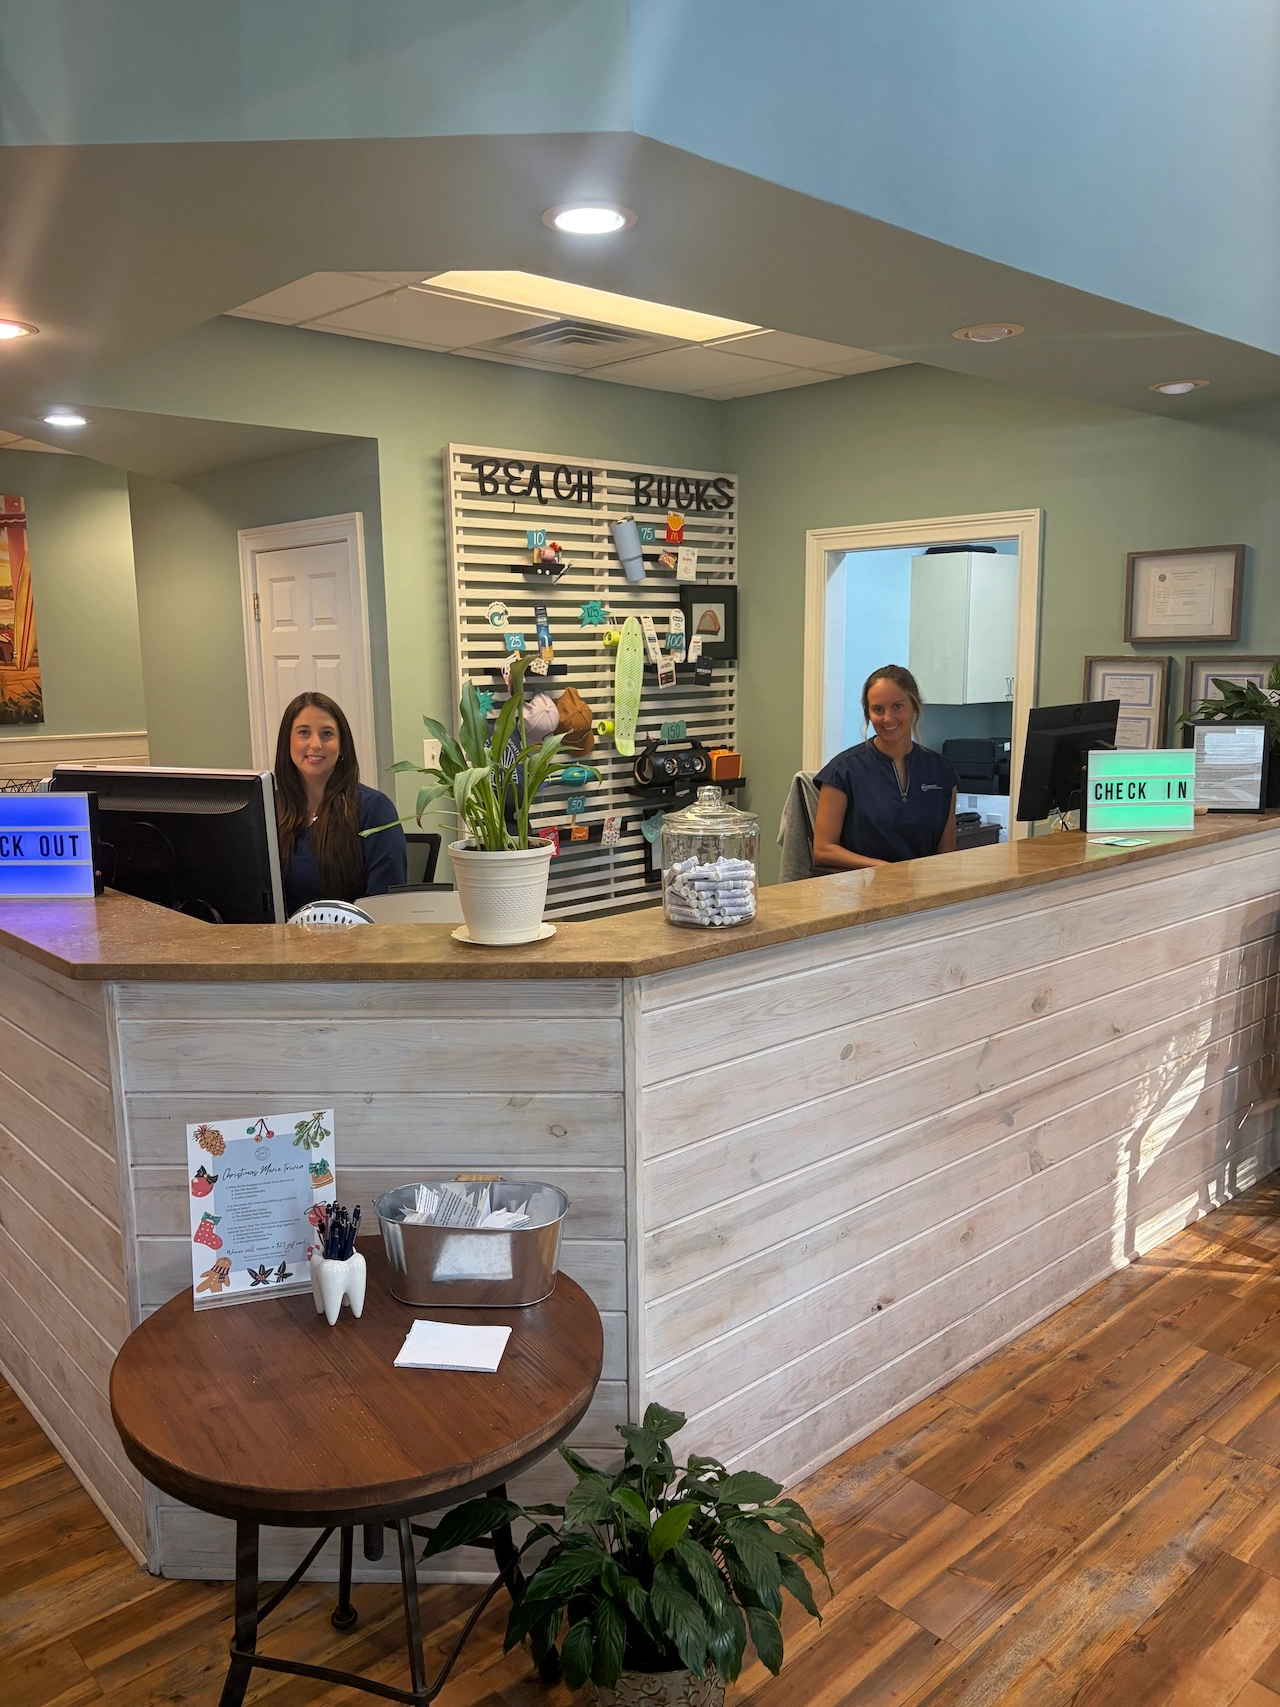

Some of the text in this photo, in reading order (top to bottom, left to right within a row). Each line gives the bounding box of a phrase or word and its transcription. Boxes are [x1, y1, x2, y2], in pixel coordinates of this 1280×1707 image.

[471, 458, 734, 511] BEACH BUCKS
[533, 532, 544, 546] 10
[641, 527, 653, 541] 75
[586, 605, 600, 618] 125
[509, 635, 522, 648] 25
[666, 634, 683, 647] 100
[667, 724, 681, 739] 150
[1094, 781, 1187, 800] CHECK IN
[571, 799, 583, 811] 50
[39, 835, 79, 857] OUT
[222, 1166, 259, 1181] Christmas
